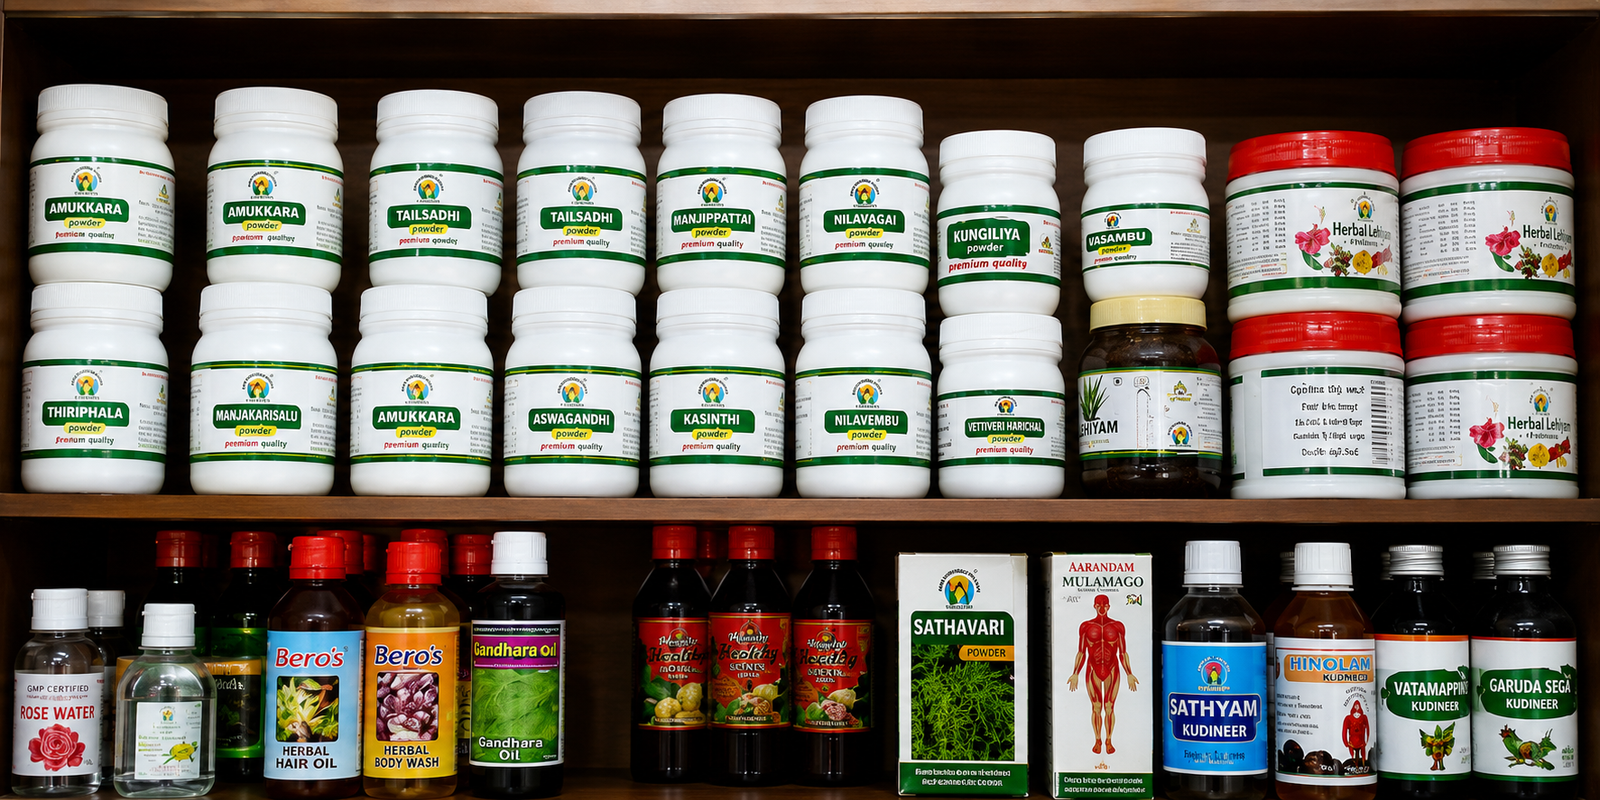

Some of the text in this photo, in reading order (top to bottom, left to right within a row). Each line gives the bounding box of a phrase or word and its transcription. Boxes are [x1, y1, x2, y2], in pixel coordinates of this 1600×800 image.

[49, 201, 122, 216] AMUKKARA
[228, 205, 299, 219] AMUKKARA
[396, 209, 460, 222] TAILSADHI
[550, 211, 613, 224] TAILSADHI
[673, 212, 752, 226] MANJIPPATTAI
[834, 213, 897, 226] NILAVAGAI
[246, 219, 279, 230] powder
[412, 224, 444, 235] powder
[566, 225, 597, 236] powder
[1332, 221, 1367, 237] Herbal
[695, 227, 727, 238] powder
[849, 227, 880, 239] powder
[953, 227, 1021, 243] KUNGILIYA
[1088, 231, 1146, 247] VASAMBU
[1523, 224, 1552, 241] Herbal
[586, 238, 610, 248] quality
[681, 239, 744, 250] premium quality
[967, 242, 1004, 254] powder
[948, 259, 989, 274] premium
[47, 406, 123, 419] THIRIPHALA
[216, 409, 298, 422] MANJAKARISALU
[377, 410, 455, 424] AMUKKARA
[533, 413, 610, 426] ASWAGANDHI
[684, 413, 740, 426] KASINTHI
[835, 414, 899, 427] NILAVEMBU
[968, 420, 1042, 432] VETTIVERI HARICHAL
[1507, 416, 1545, 431] Herbal
[68, 422, 102, 433] powder
[239, 425, 272, 436] powder
[400, 427, 433, 438] powder
[555, 428, 588, 440] powder
[696, 429, 728, 440] powder
[851, 429, 883, 440] powder
[991, 433, 1022, 444] powder
[261, 440, 288, 449] quality
[540, 442, 575, 452] premium
[682, 442, 741, 453] premium quality
[871, 443, 897, 453] quality
[1068, 561, 1135, 573] AARANDAM
[1062, 576, 1144, 588] MULAMAGO
[913, 618, 1005, 636] SATHAVARI
[374, 644, 444, 666] Bero's
[474, 641, 537, 658] Gandhara
[967, 648, 1006, 658] POWDER
[275, 646, 345, 668] Bero's
[1289, 656, 1371, 672] HINOLAM
[27, 684, 89, 693] GMP CERTIFIED
[1489, 678, 1542, 694] GARUDA
[1170, 698, 1258, 718] SATHYAM
[1411, 701, 1460, 712] KUDINEER
[1505, 698, 1559, 710] KUDINEER
[20, 705, 95, 720] ROSE WATER
[1182, 723, 1247, 738] KUDINEER
[478, 736, 543, 749] Gandhara
[282, 745, 330, 757] HERBAL
[383, 745, 430, 756] HERBAL
[276, 757, 337, 770] HAIR OIL
[375, 756, 440, 769] BODY WASH
